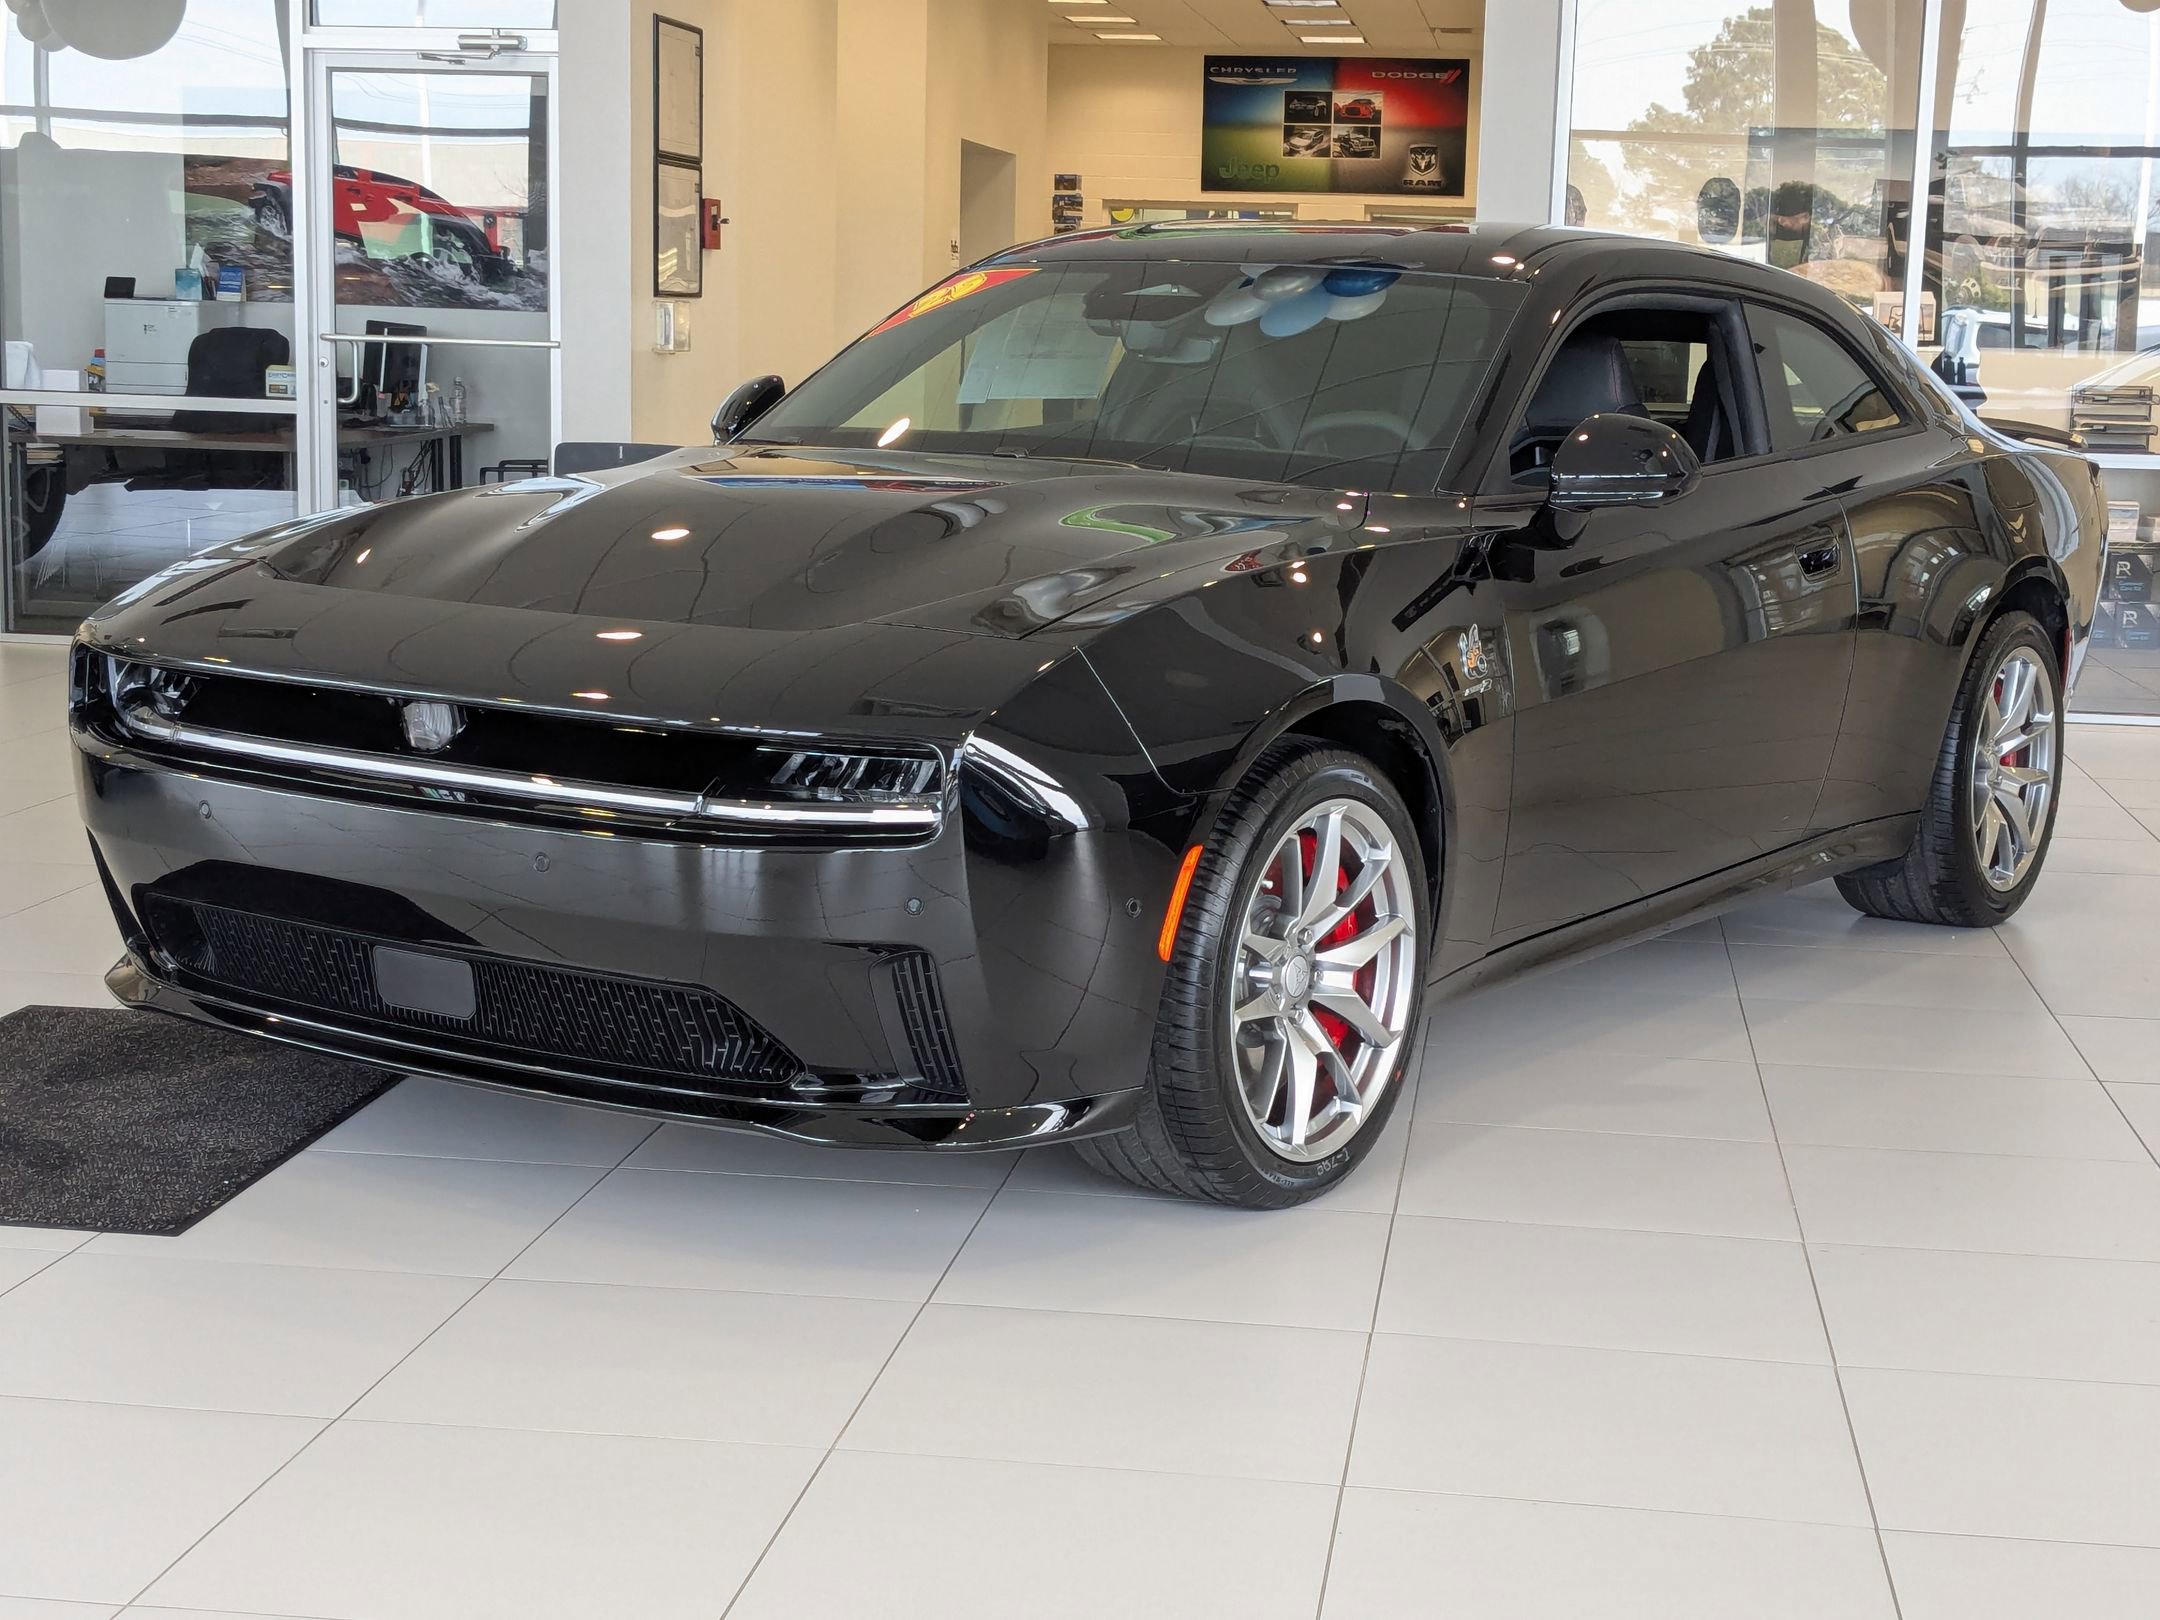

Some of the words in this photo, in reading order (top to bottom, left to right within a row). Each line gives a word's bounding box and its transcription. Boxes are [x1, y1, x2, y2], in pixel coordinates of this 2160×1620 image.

[1209, 66, 1297, 74] CHRYSLER
[1371, 71, 1448, 79] DODGE
[1218, 157, 1280, 185] Jeep
[1403, 179, 1442, 187] RAM
[2116, 560, 2132, 576] R
[2122, 610, 2138, 625] R
